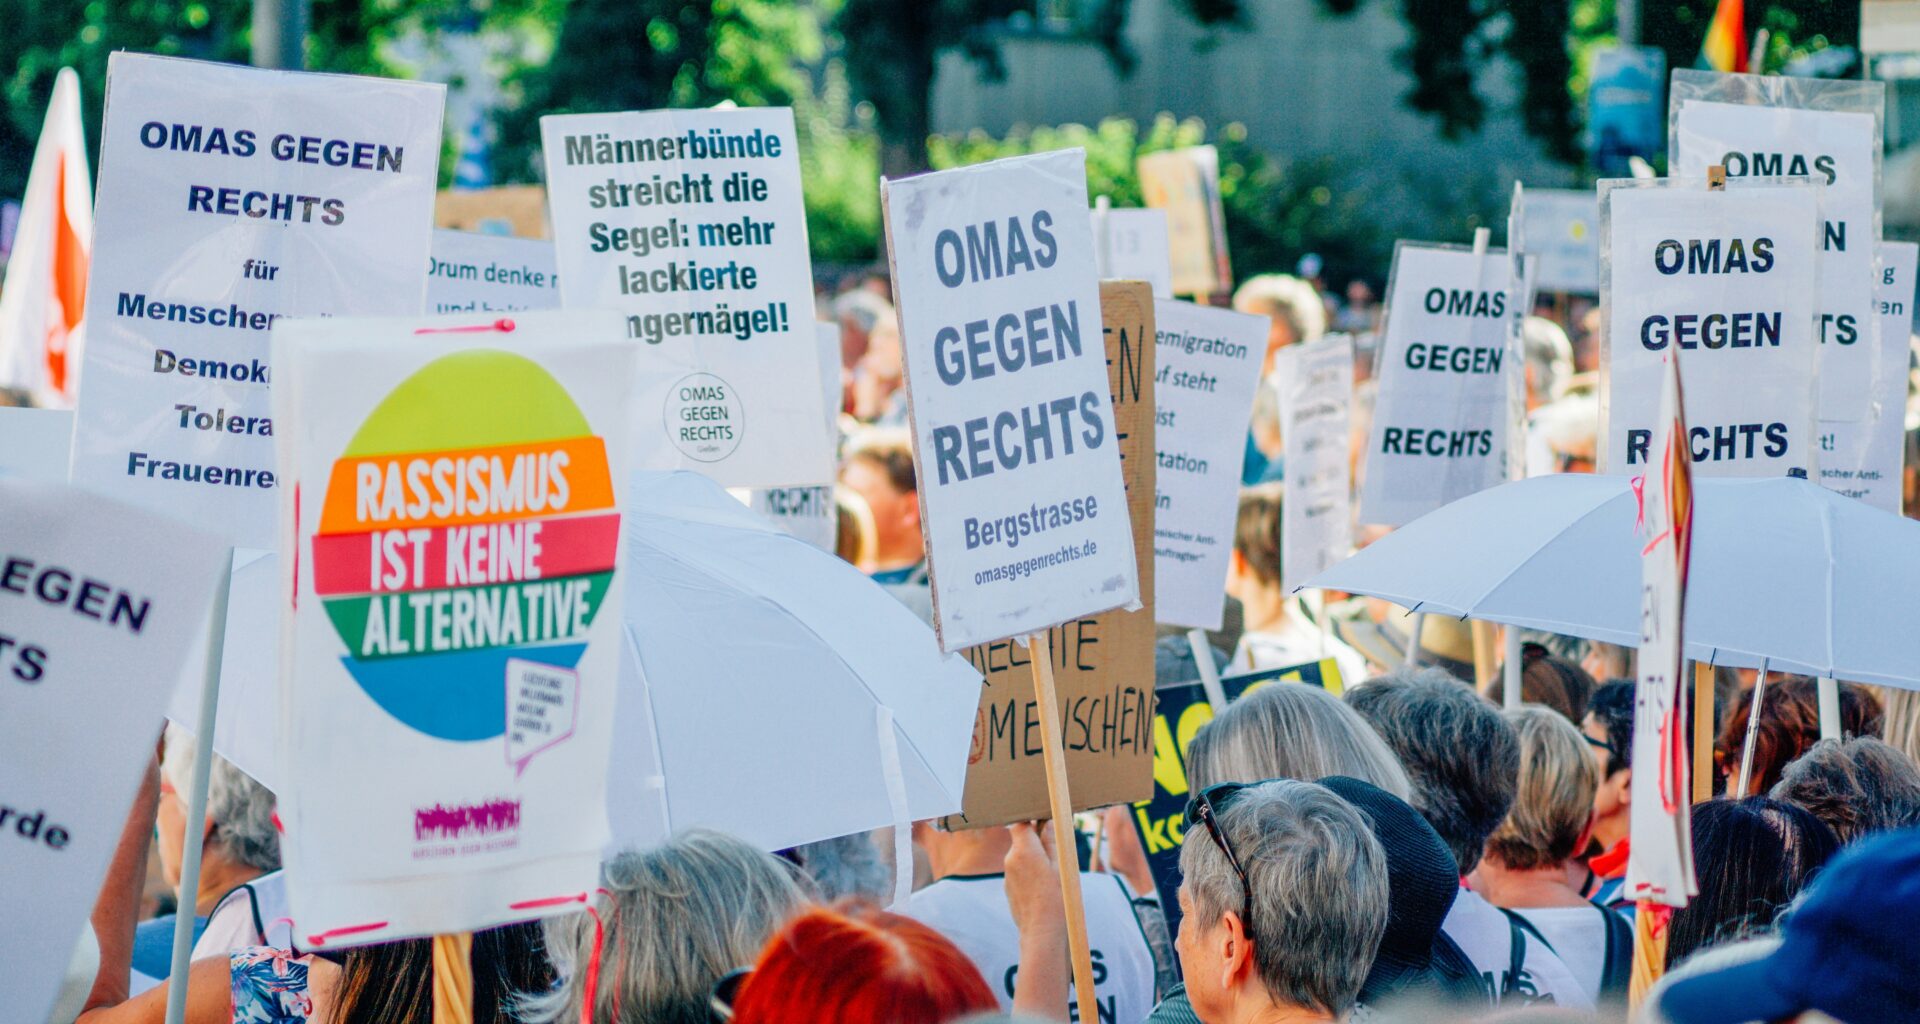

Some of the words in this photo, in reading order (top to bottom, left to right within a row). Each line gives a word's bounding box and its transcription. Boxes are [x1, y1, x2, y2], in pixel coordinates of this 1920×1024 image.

[140, 121, 256, 158] OMAS
[271, 134, 404, 173] GEGEN
[565, 128, 782, 166] Männerbünde
[1721, 151, 1837, 186] OMAS
[188, 185, 345, 226] RECHTS
[589, 173, 714, 209] streicht
[723, 171, 768, 202] die
[589, 217, 689, 257] Segel:
[698, 215, 775, 247] mehr
[934, 209, 1058, 289] OMAS
[243, 259, 279, 281] für
[484, 262, 545, 288] denke
[1655, 237, 1775, 275] OMAS
[618, 260, 757, 295] lackierte
[1424, 287, 1506, 318] OMAS
[933, 299, 1082, 387] GEGEN
[1640, 311, 1783, 351] GEGEN
[153, 349, 271, 383] Demok
[1405, 343, 1503, 375] GEGEN
[679, 386, 725, 402] OMAS
[1172, 370, 1217, 393] steht
[680, 406, 729, 422] GEGEN
[680, 426, 734, 441] RECHTS
[932, 391, 1104, 487] RECHTS
[1382, 427, 1492, 458] RECHTS
[1626, 422, 1789, 465] RCHTS
[127, 451, 279, 489] Frauenre
[356, 450, 571, 523] RASSISMUS
[964, 495, 1098, 550] Bergstrasse
[370, 528, 432, 590] IST
[446, 521, 543, 586] KEINE
[974, 538, 1097, 585] omasgegenrechts.de
[0, 556, 151, 634] EGEN
[361, 578, 592, 657] ALTERNATIVE
